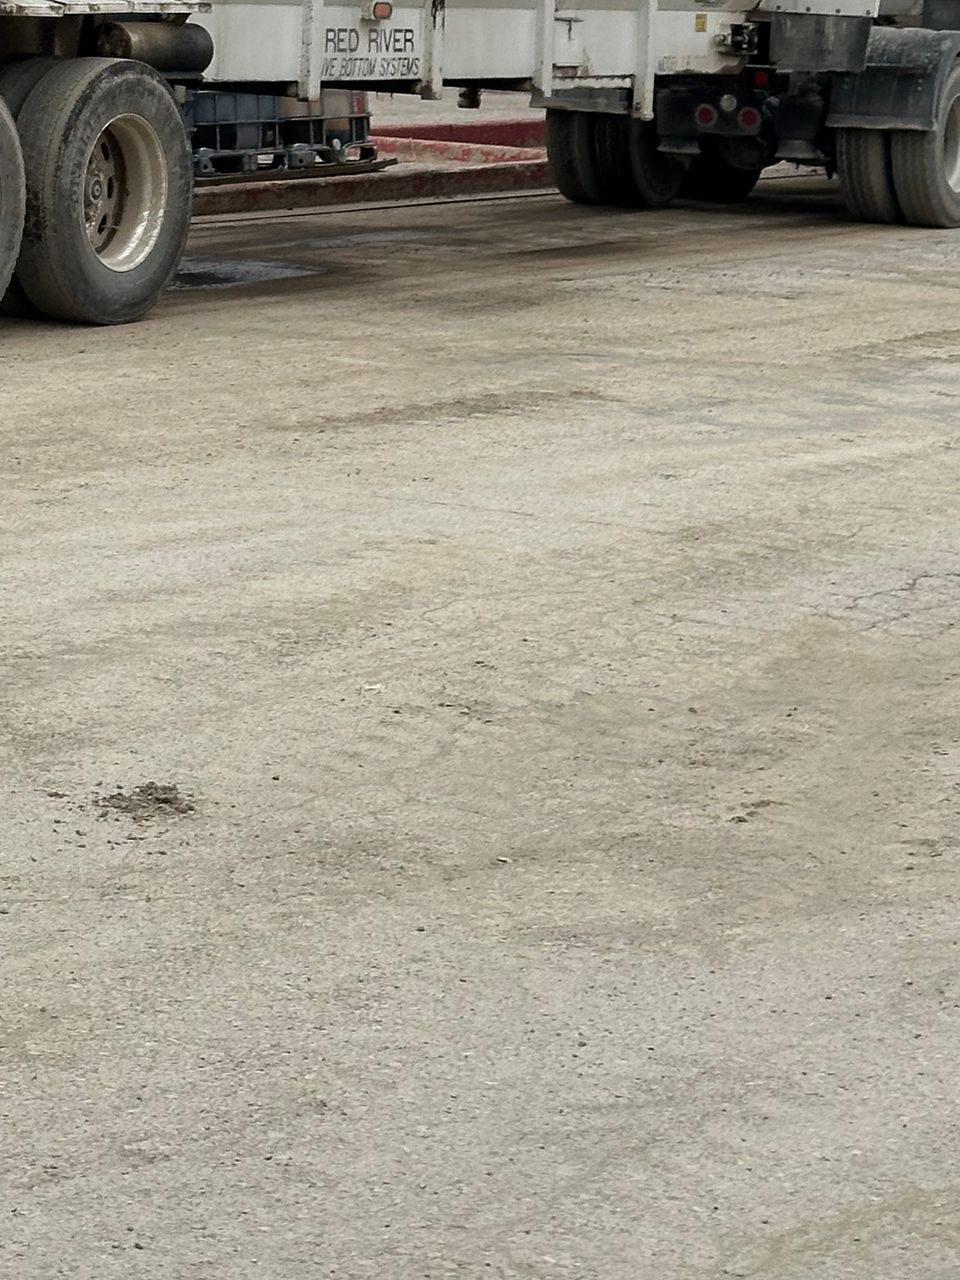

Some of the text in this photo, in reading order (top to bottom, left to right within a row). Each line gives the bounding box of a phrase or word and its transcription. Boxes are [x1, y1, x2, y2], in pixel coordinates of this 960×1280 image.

[325, 28, 415, 53] RED RIVER
[340, 57, 378, 77] BOTTOM
[380, 57, 420, 77] SYSTEMS
